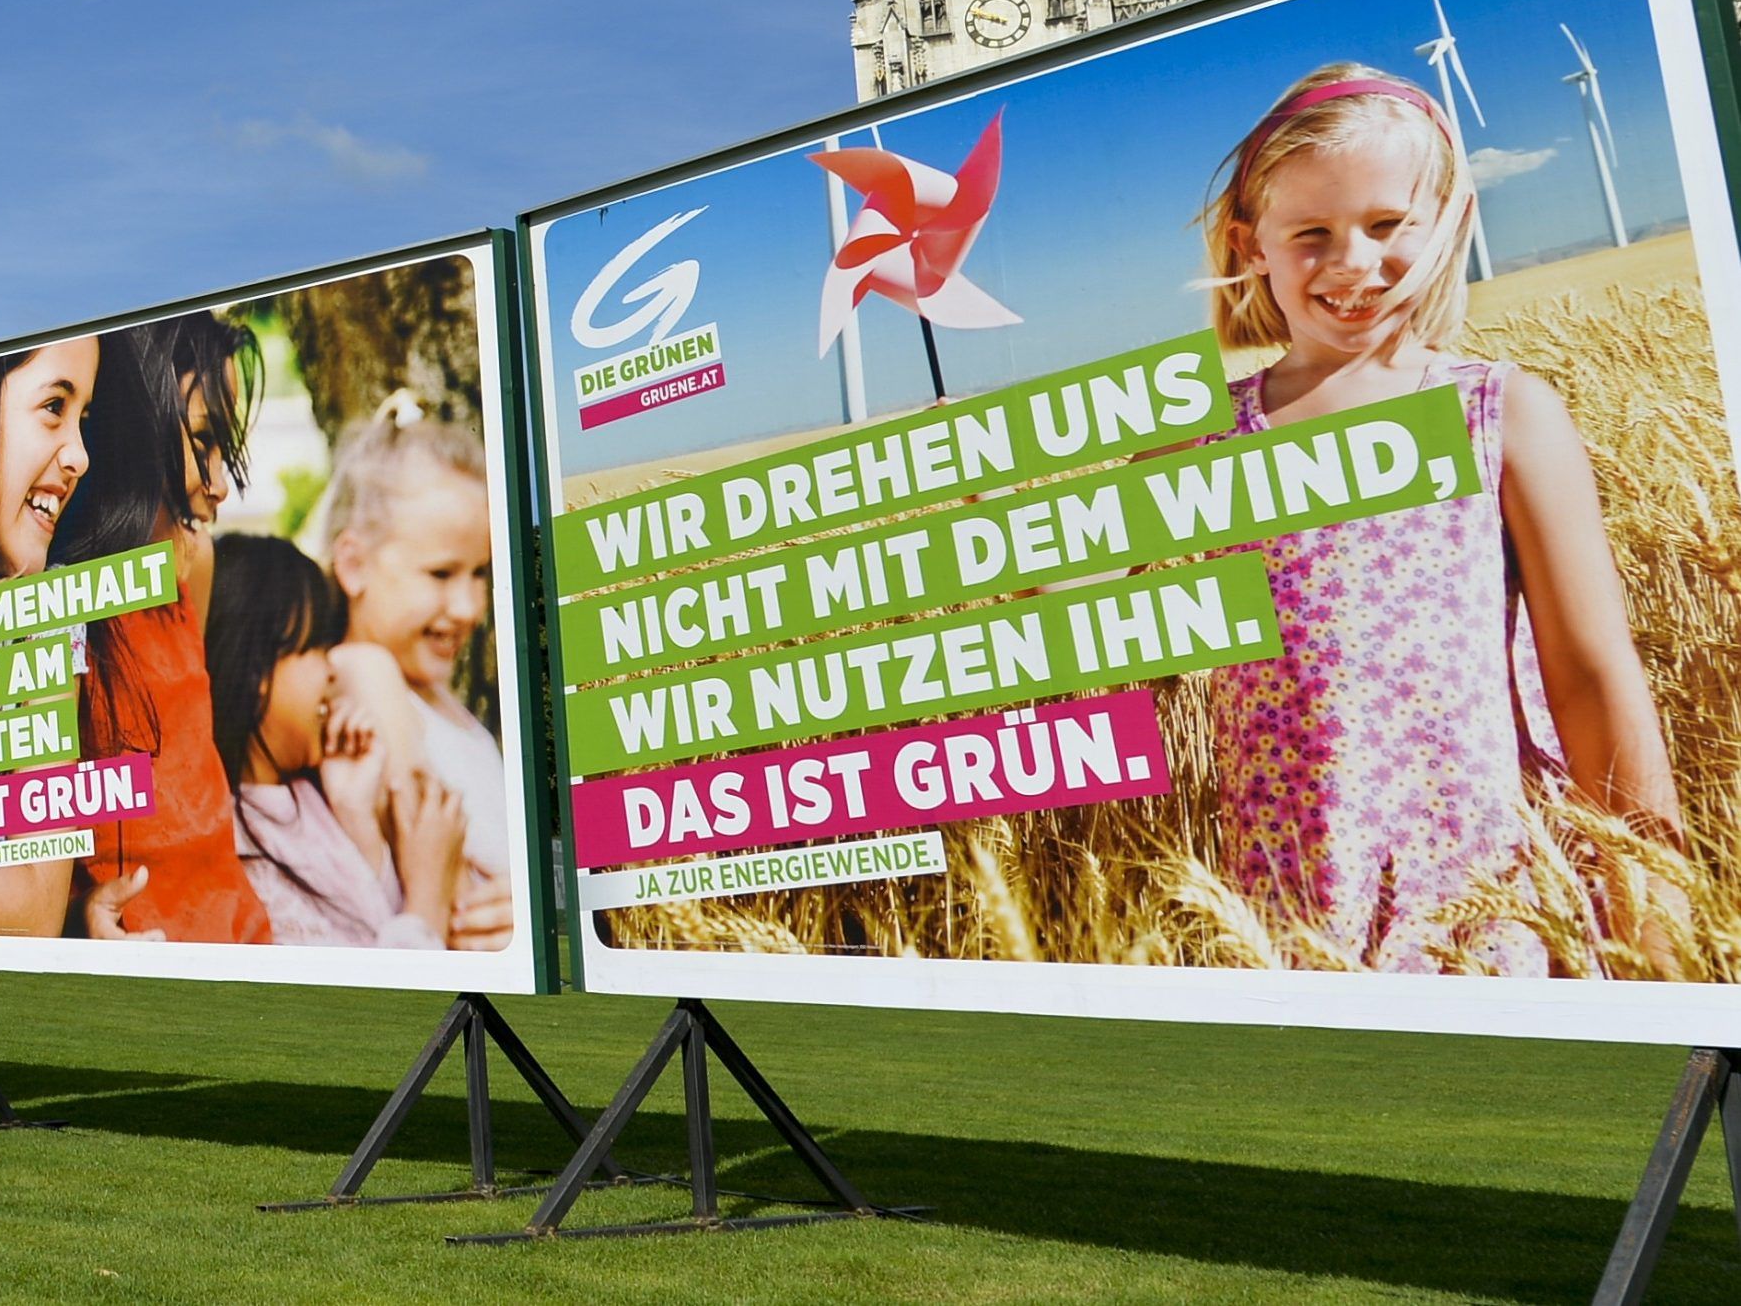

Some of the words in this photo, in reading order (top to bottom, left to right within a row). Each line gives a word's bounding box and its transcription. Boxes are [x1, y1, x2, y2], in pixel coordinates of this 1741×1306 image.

[580, 365, 616, 396] DIE
[619, 332, 715, 382] GRÜNEN
[640, 369, 718, 407] GRUENE.AT
[586, 492, 712, 574] WIR
[722, 405, 1015, 540] DREHEN
[1029, 352, 1212, 457] UNS
[599, 564, 787, 665] NICHT
[805, 529, 929, 620] MIT
[951, 485, 1130, 587] DEM
[1144, 421, 1458, 541] WIND,
[7, 643, 67, 696] AM
[609, 677, 738, 755] WIR
[749, 612, 1051, 730] NUTZEN
[1067, 576, 1262, 674] IHN.
[20, 760, 147, 824] GRÜN.
[622, 772, 750, 849] DAS
[764, 751, 870, 828] IST
[893, 709, 1151, 810] GRÜN.
[635, 873, 662, 899] JA
[668, 867, 714, 896] ZUR
[720, 840, 940, 890] ENERGIEWENDE.
